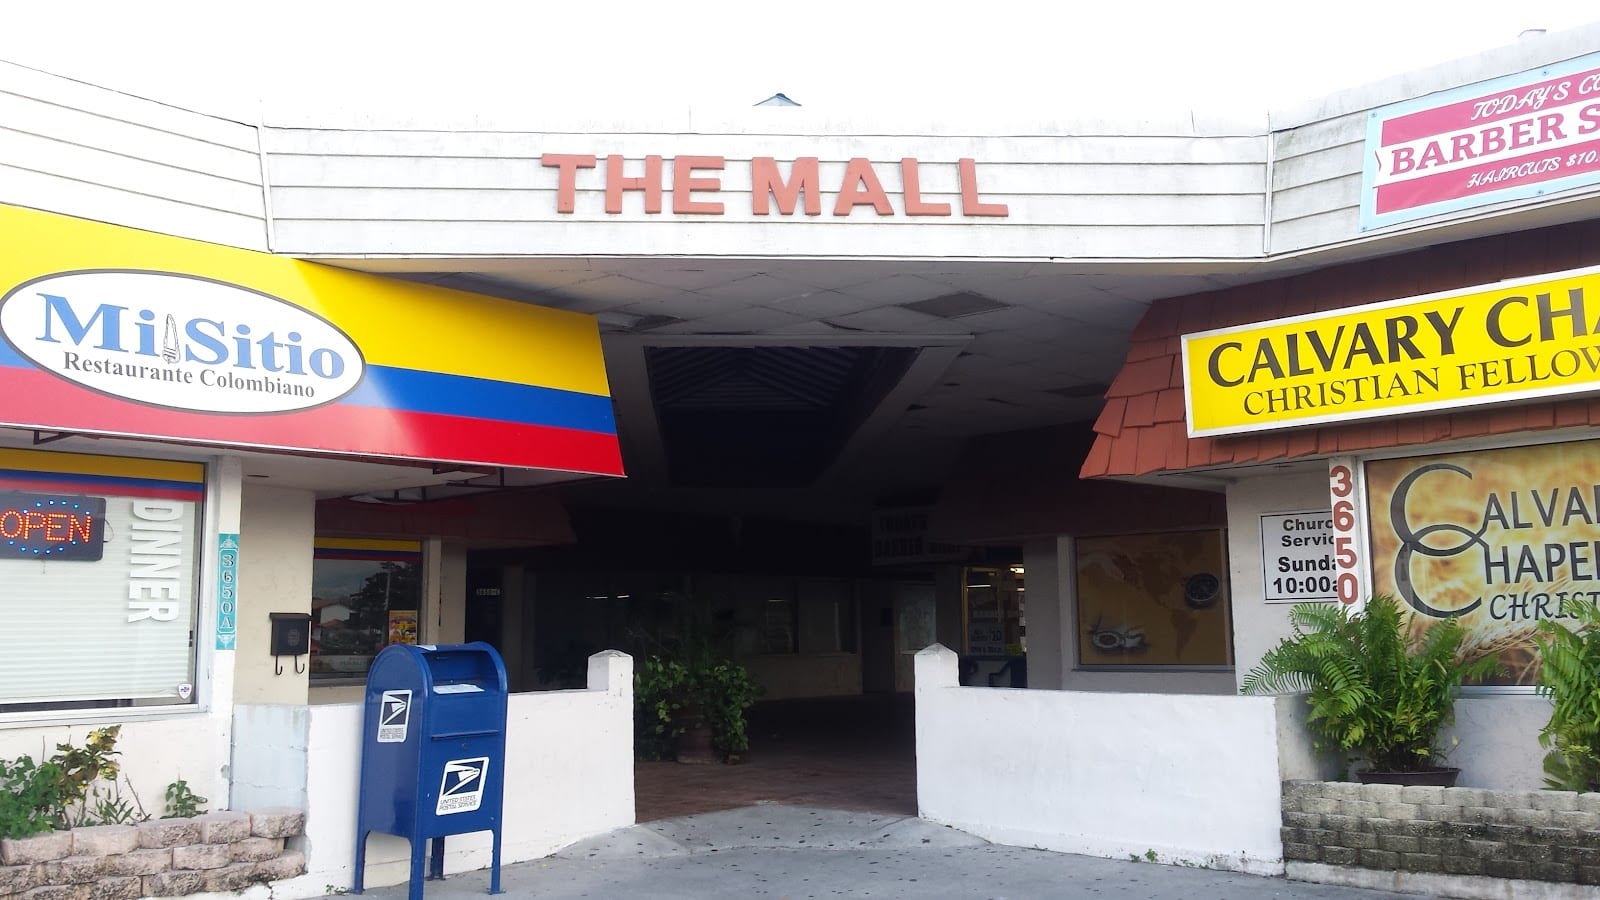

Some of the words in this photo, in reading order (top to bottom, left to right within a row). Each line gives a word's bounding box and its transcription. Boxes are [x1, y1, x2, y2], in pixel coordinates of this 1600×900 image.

[1471, 82, 1571, 120] TODAY'S
[1390, 113, 1567, 176] BARBER
[1578, 103, 1600, 135] S
[1467, 157, 1561, 188] HAIRCUTS
[541, 153, 725, 214] THE
[751, 157, 1009, 217] MALL
[35, 292, 160, 358] Mi
[185, 318, 346, 379] Sitio
[1208, 307, 1465, 388] CALVARY
[1485, 287, 1600, 347] CH
[63, 351, 193, 385] Restaurante
[200, 368, 315, 398] Colombiano
[1243, 367, 1440, 416] CHRISTIAN
[0, 510, 92, 543] OPEN
[1330, 465, 1359, 605] 3650
[128, 500, 184, 623] DINNER
[221, 553, 234, 629] 3650A
